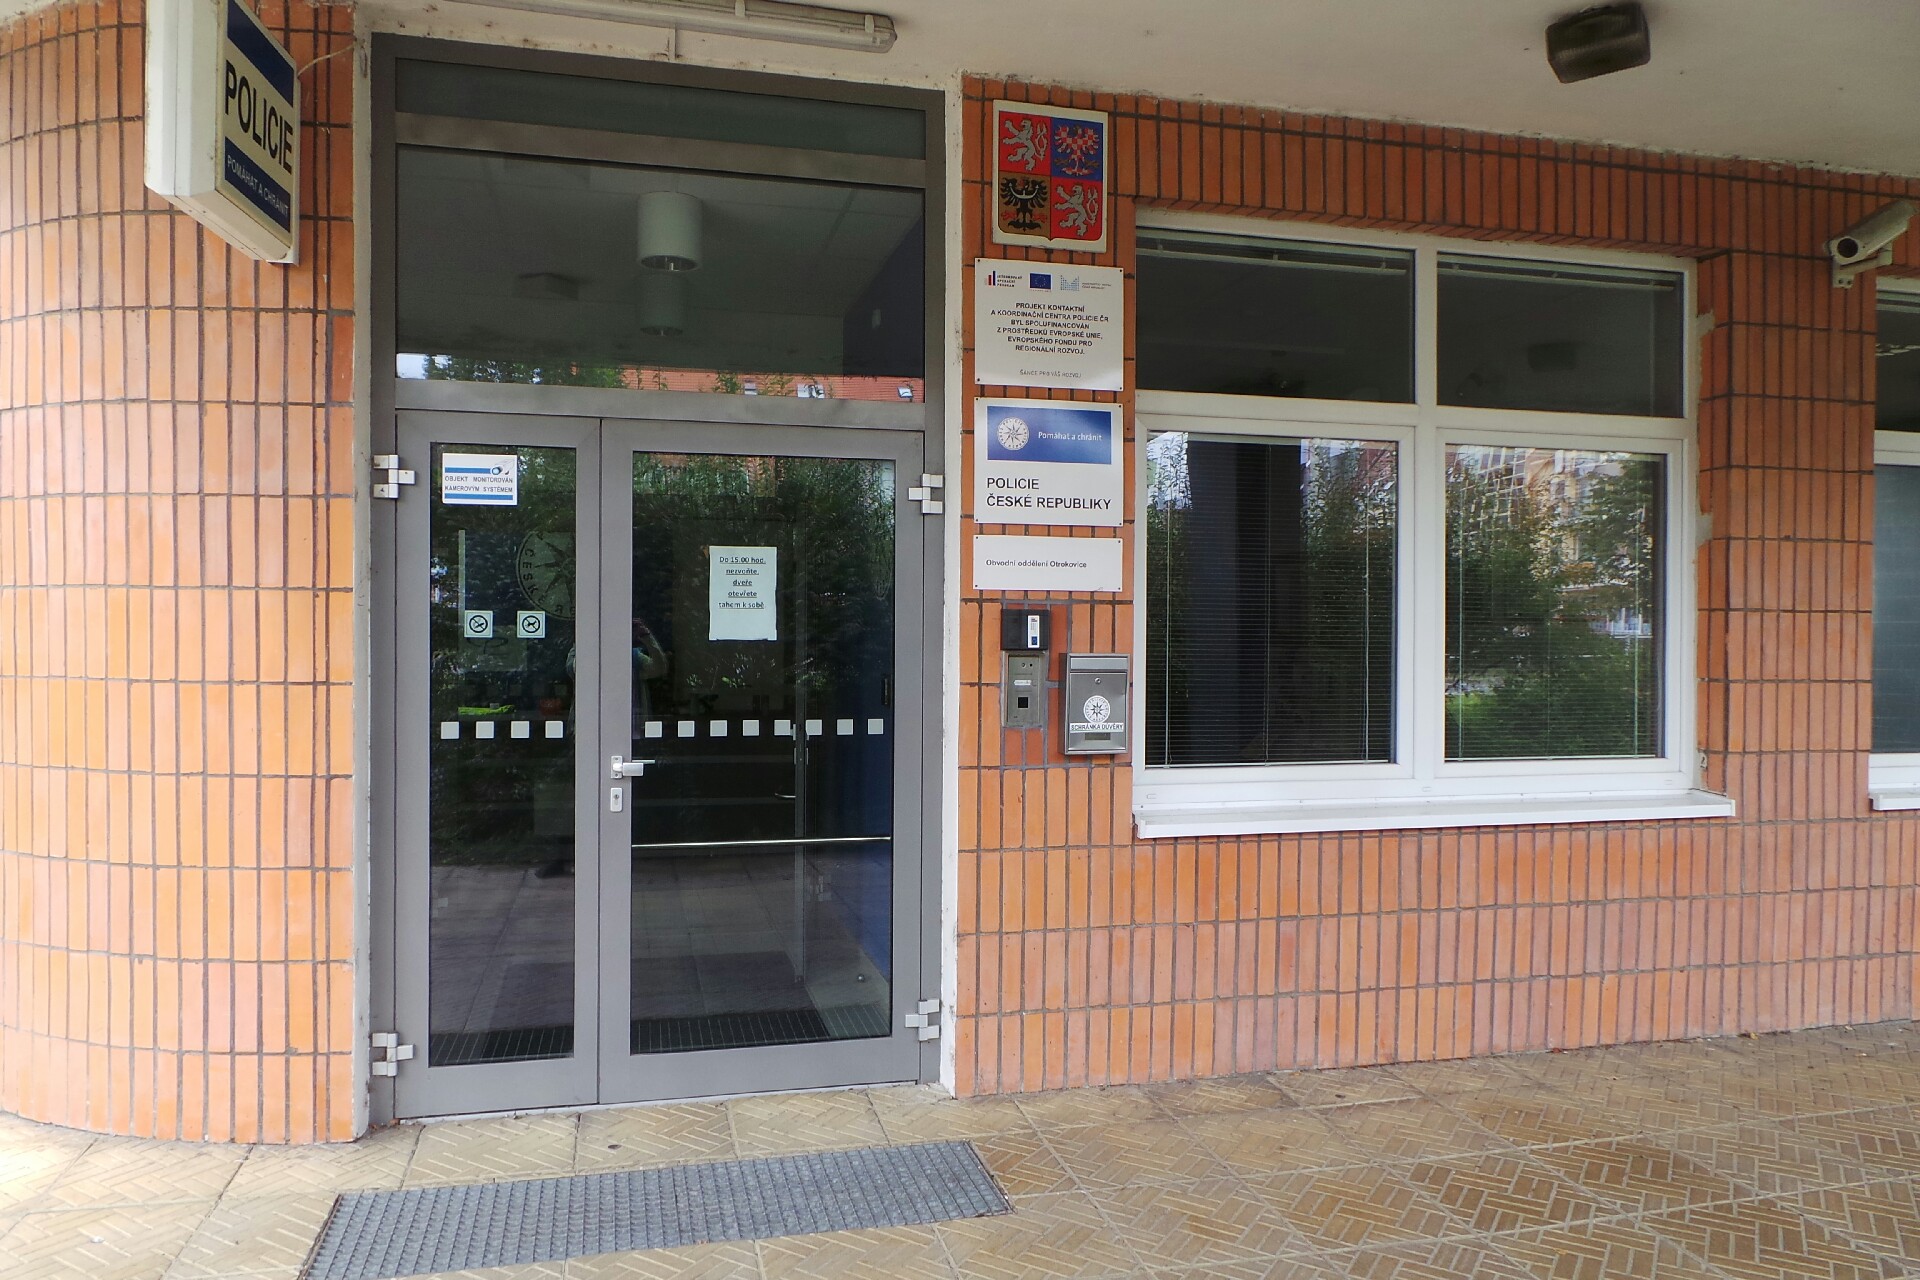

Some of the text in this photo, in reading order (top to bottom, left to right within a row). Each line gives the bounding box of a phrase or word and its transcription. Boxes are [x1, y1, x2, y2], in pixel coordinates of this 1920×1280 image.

[225, 59, 293, 173] POLICIE
[227, 154, 258, 190] POMÁHAT
[258, 183, 263, 197] A
[1015, 302, 1085, 312] PROJEKT KONTAKTNÍ
[997, 309, 1044, 319] KOORDINAČNÍ
[1044, 312, 1071, 320] CENTRA
[1072, 314, 1099, 322] POLICIE
[1099, 314, 1109, 322] ČR
[1025, 319, 1090, 329] SPOLUFINANCOVÁN
[1002, 327, 1048, 336] PROSTŘEDKŮ
[1049, 329, 1085, 338] EVROPSKÉ
[1085, 332, 1103, 340] UNIE,
[1007, 335, 1054, 345] EVROPSKÉHO
[1015, 344, 1086, 355] REGIONÁLNÍ ROZVOJ.
[1038, 431, 1070, 440] Pomáhat
[1077, 432, 1103, 441] chránit
[472, 476, 513, 484] MONITOROVÁN
[986, 477, 1040, 490] POLICIE
[444, 484, 513, 493] KAMEROVÝM SYSTÉMEM
[986, 493, 1112, 510] ČESKÉ REPUBLIKY
[1017, 559, 1048, 567] oddělení
[1049, 560, 1087, 568] Otrokovice
[727, 590, 757, 598] otevřete
[1071, 723, 1100, 731] SCHRÁNKA
